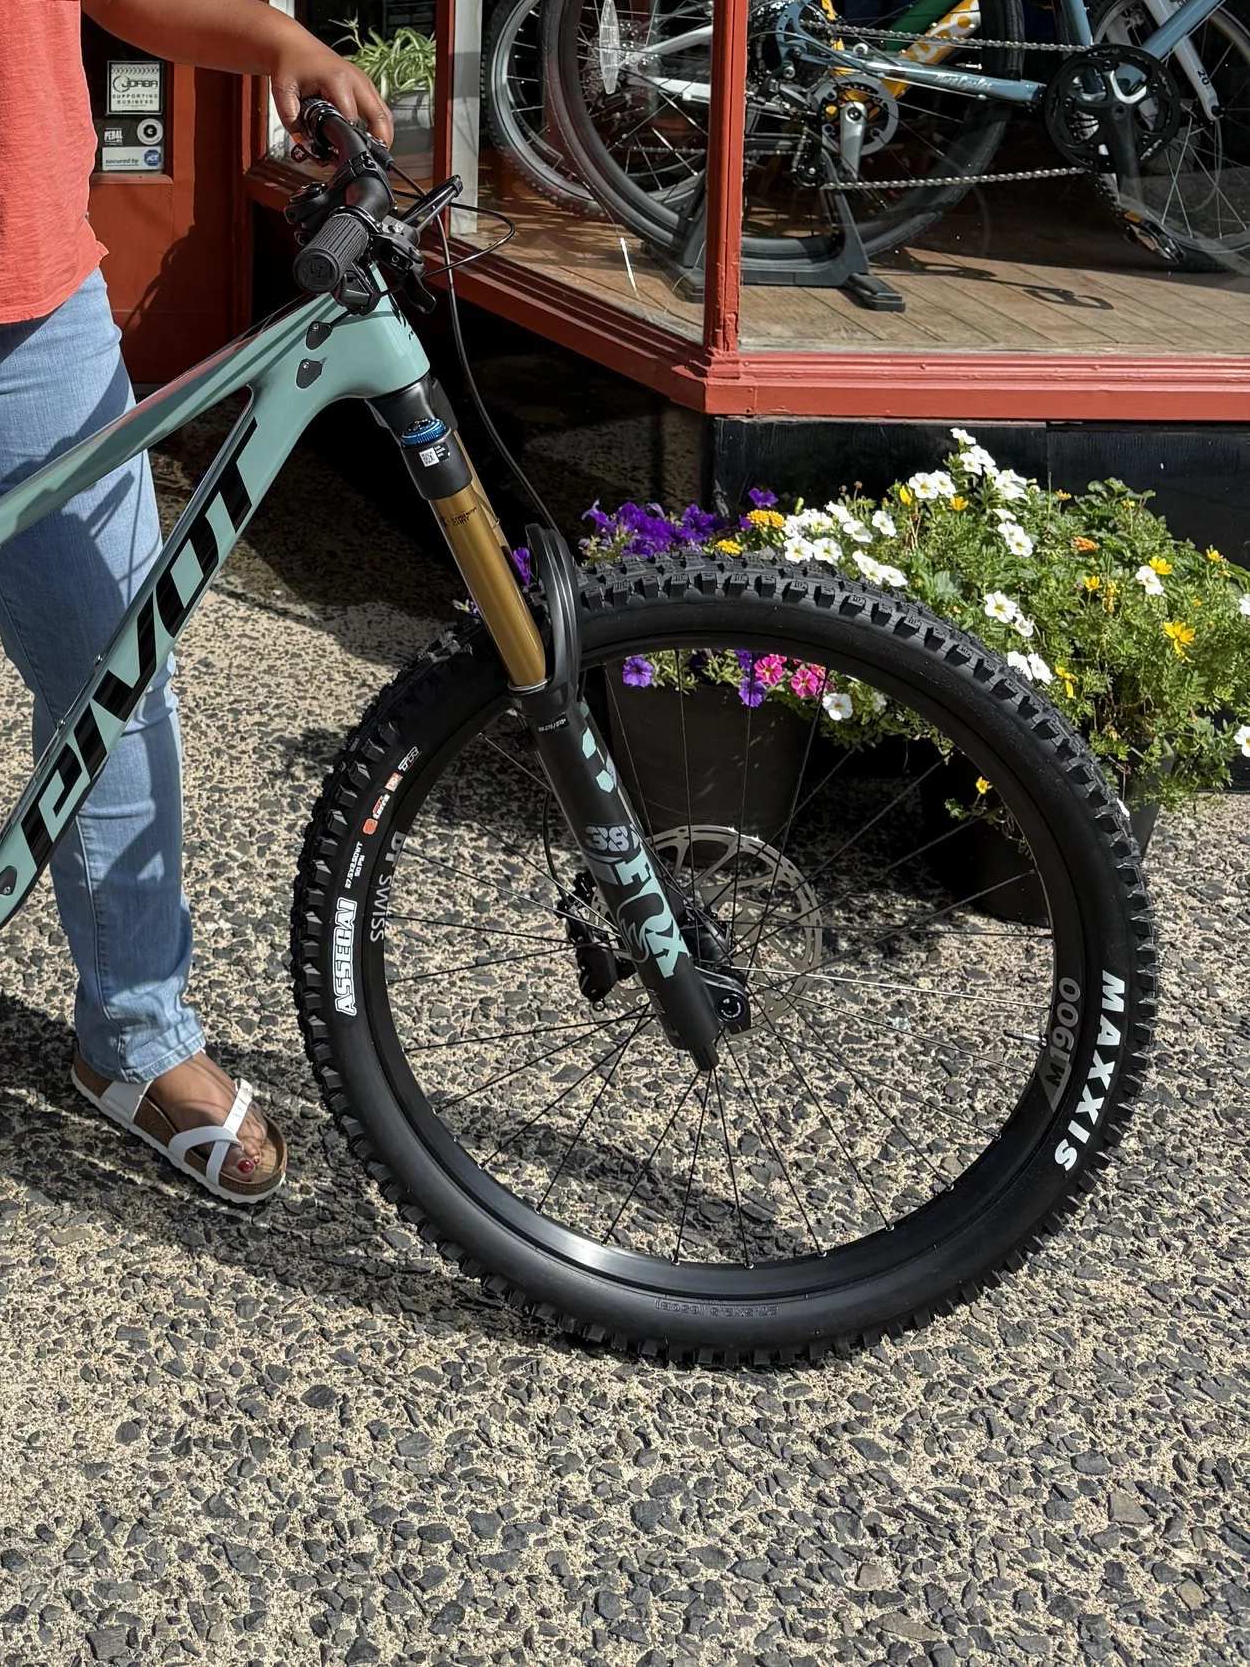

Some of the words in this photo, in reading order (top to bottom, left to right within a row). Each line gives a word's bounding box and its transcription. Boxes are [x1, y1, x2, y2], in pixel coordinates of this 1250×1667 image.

[20, 416, 258, 872] PIVOT
[585, 825, 628, 852] 38
[332, 895, 358, 1018] ASSEGAI
[369, 873, 393, 943] SWISS
[614, 848, 692, 980] FOX
[1045, 976, 1081, 1089] M1900
[1054, 969, 1126, 1172] MAXXIS
